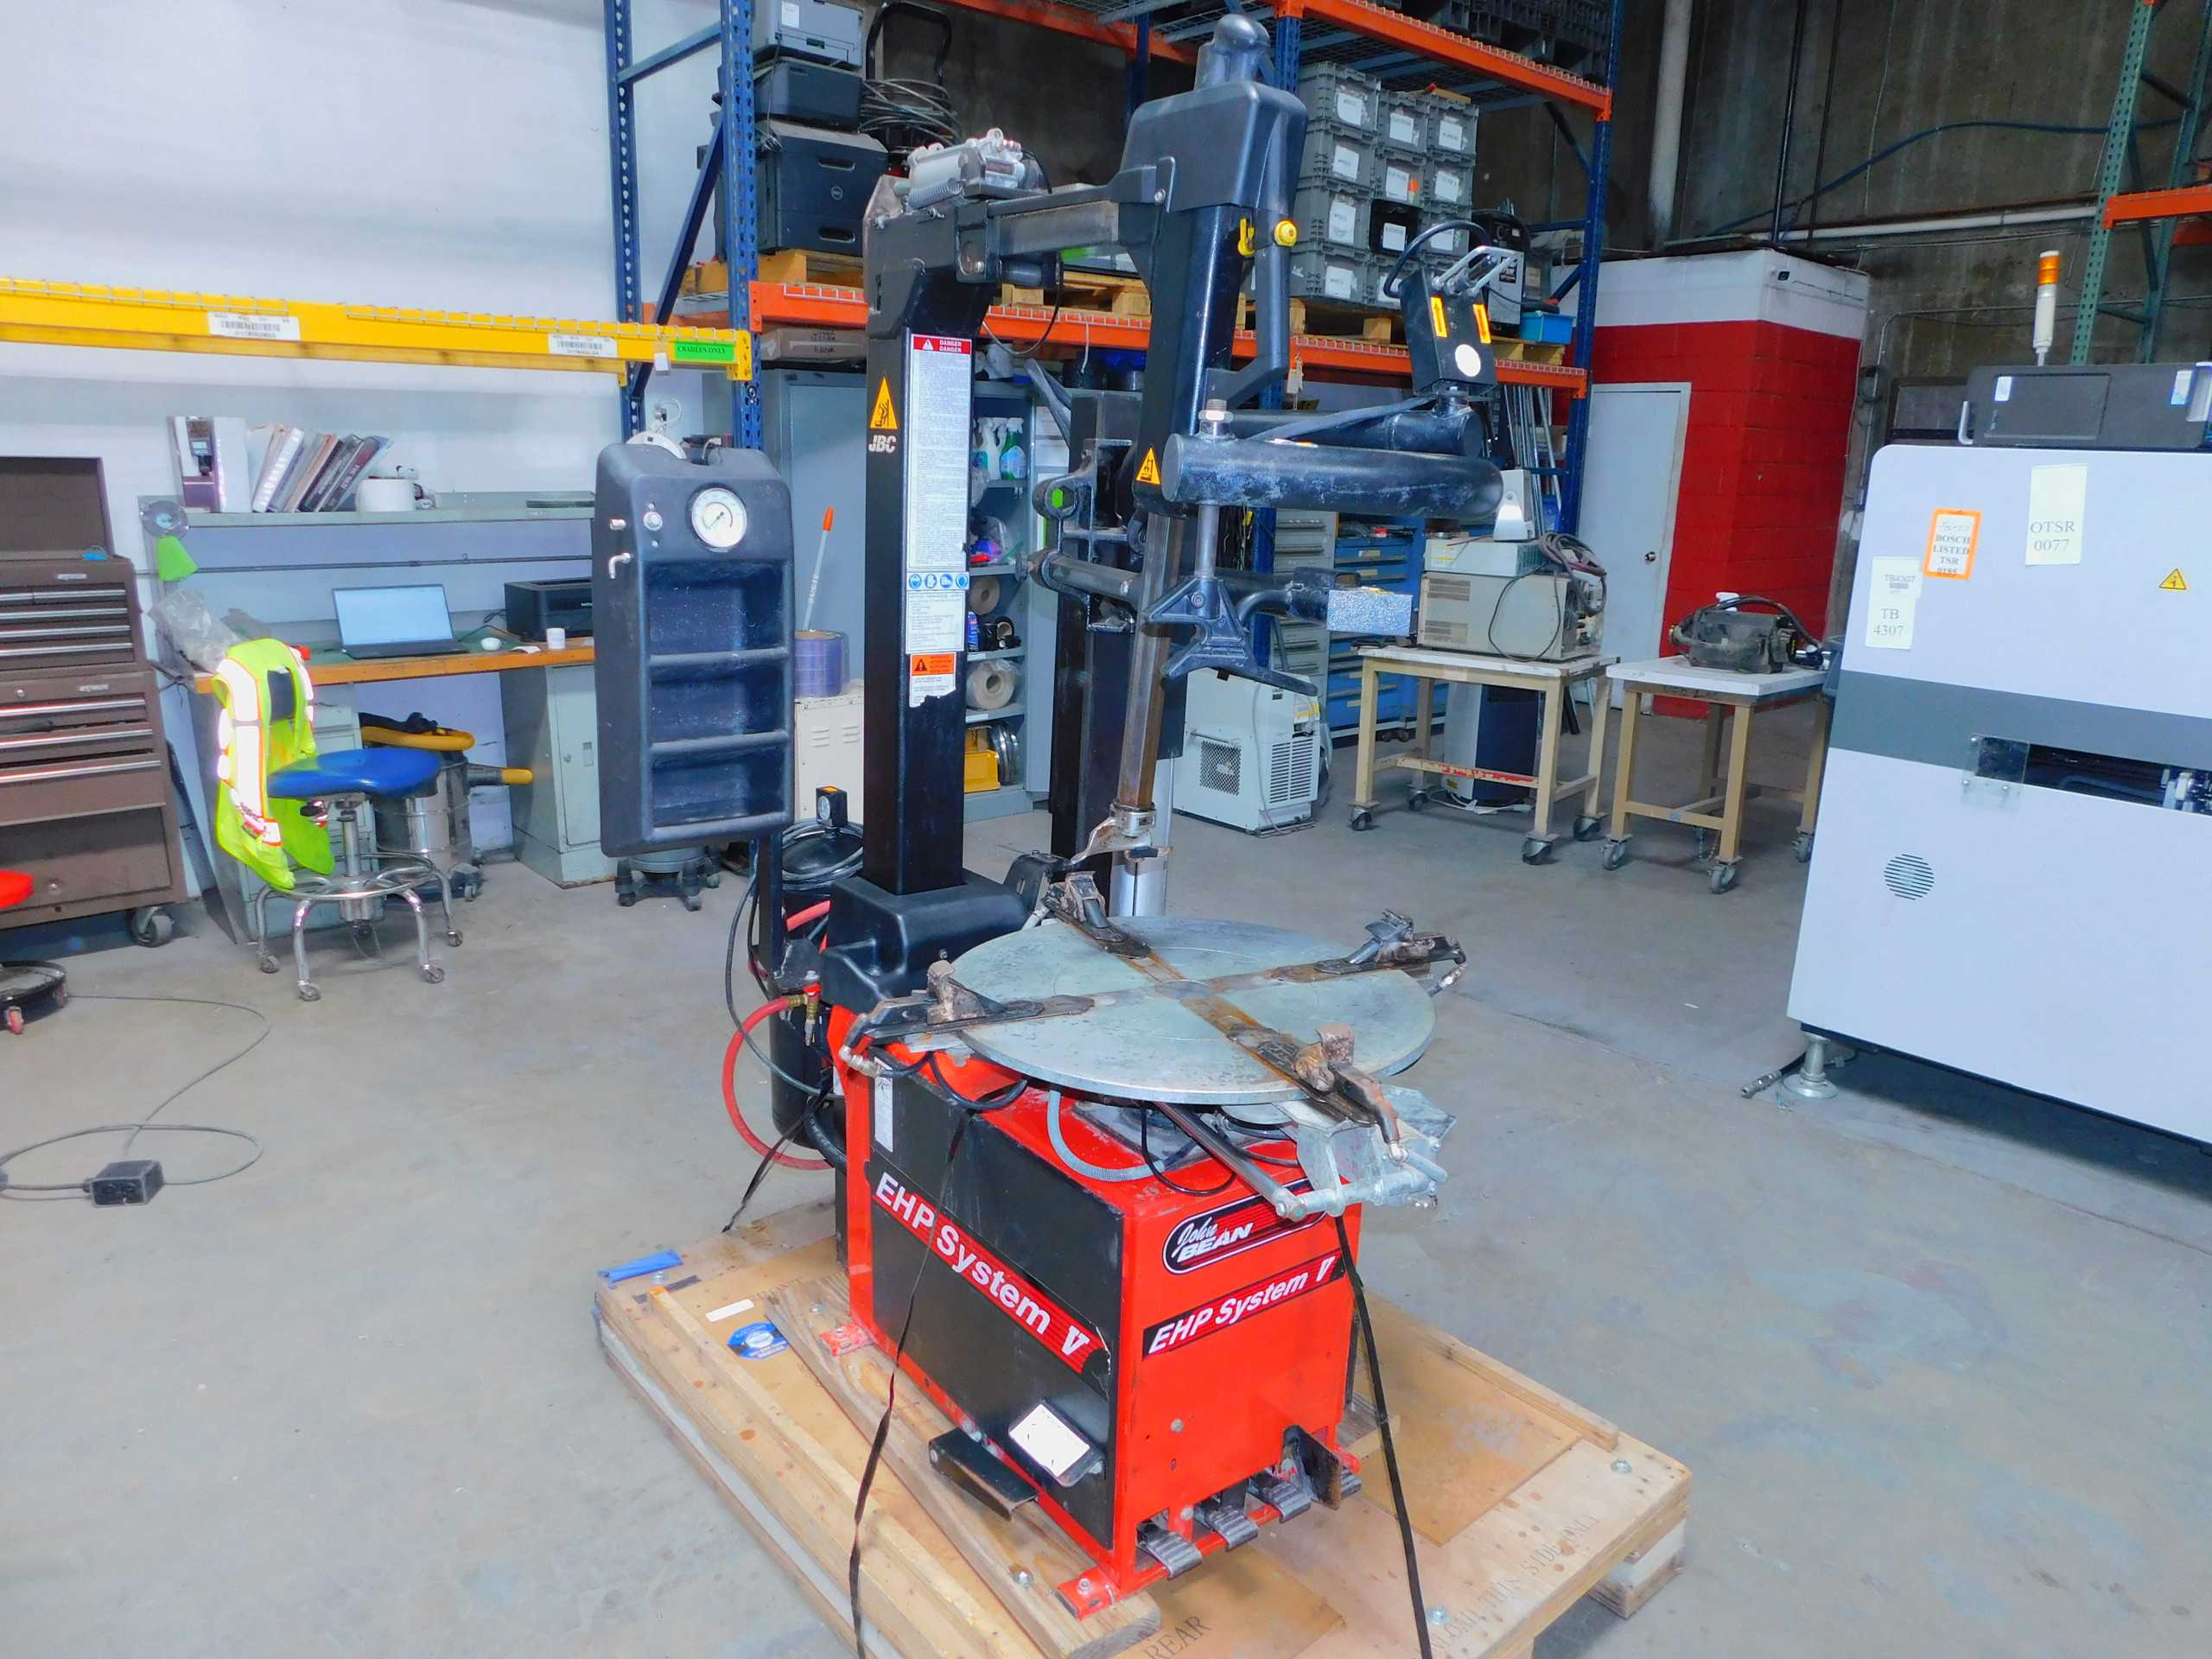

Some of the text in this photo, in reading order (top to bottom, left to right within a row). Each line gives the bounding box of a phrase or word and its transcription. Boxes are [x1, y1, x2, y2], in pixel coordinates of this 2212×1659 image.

[708, 346, 726, 354] ONLY
[868, 435, 897, 453] JBC
[2031, 520, 2075, 534] OTSR
[1936, 534, 1970, 544] BOSCH
[2033, 539, 2069, 551] 0077
[1933, 543, 1970, 555] LISTED
[1941, 556, 1959, 565] TSR
[1880, 607, 1900, 620] TB
[1873, 624, 1904, 636] 4307
[1171, 1216, 1218, 1259] John
[1177, 1222, 1254, 1262] BEAN
[875, 1172, 1090, 1357] EHP System V
[1148, 1255, 1336, 1355] EHP System V
[1520, 1543, 1562, 1575] SIDE
[1142, 1616, 1211, 1659] REAR
